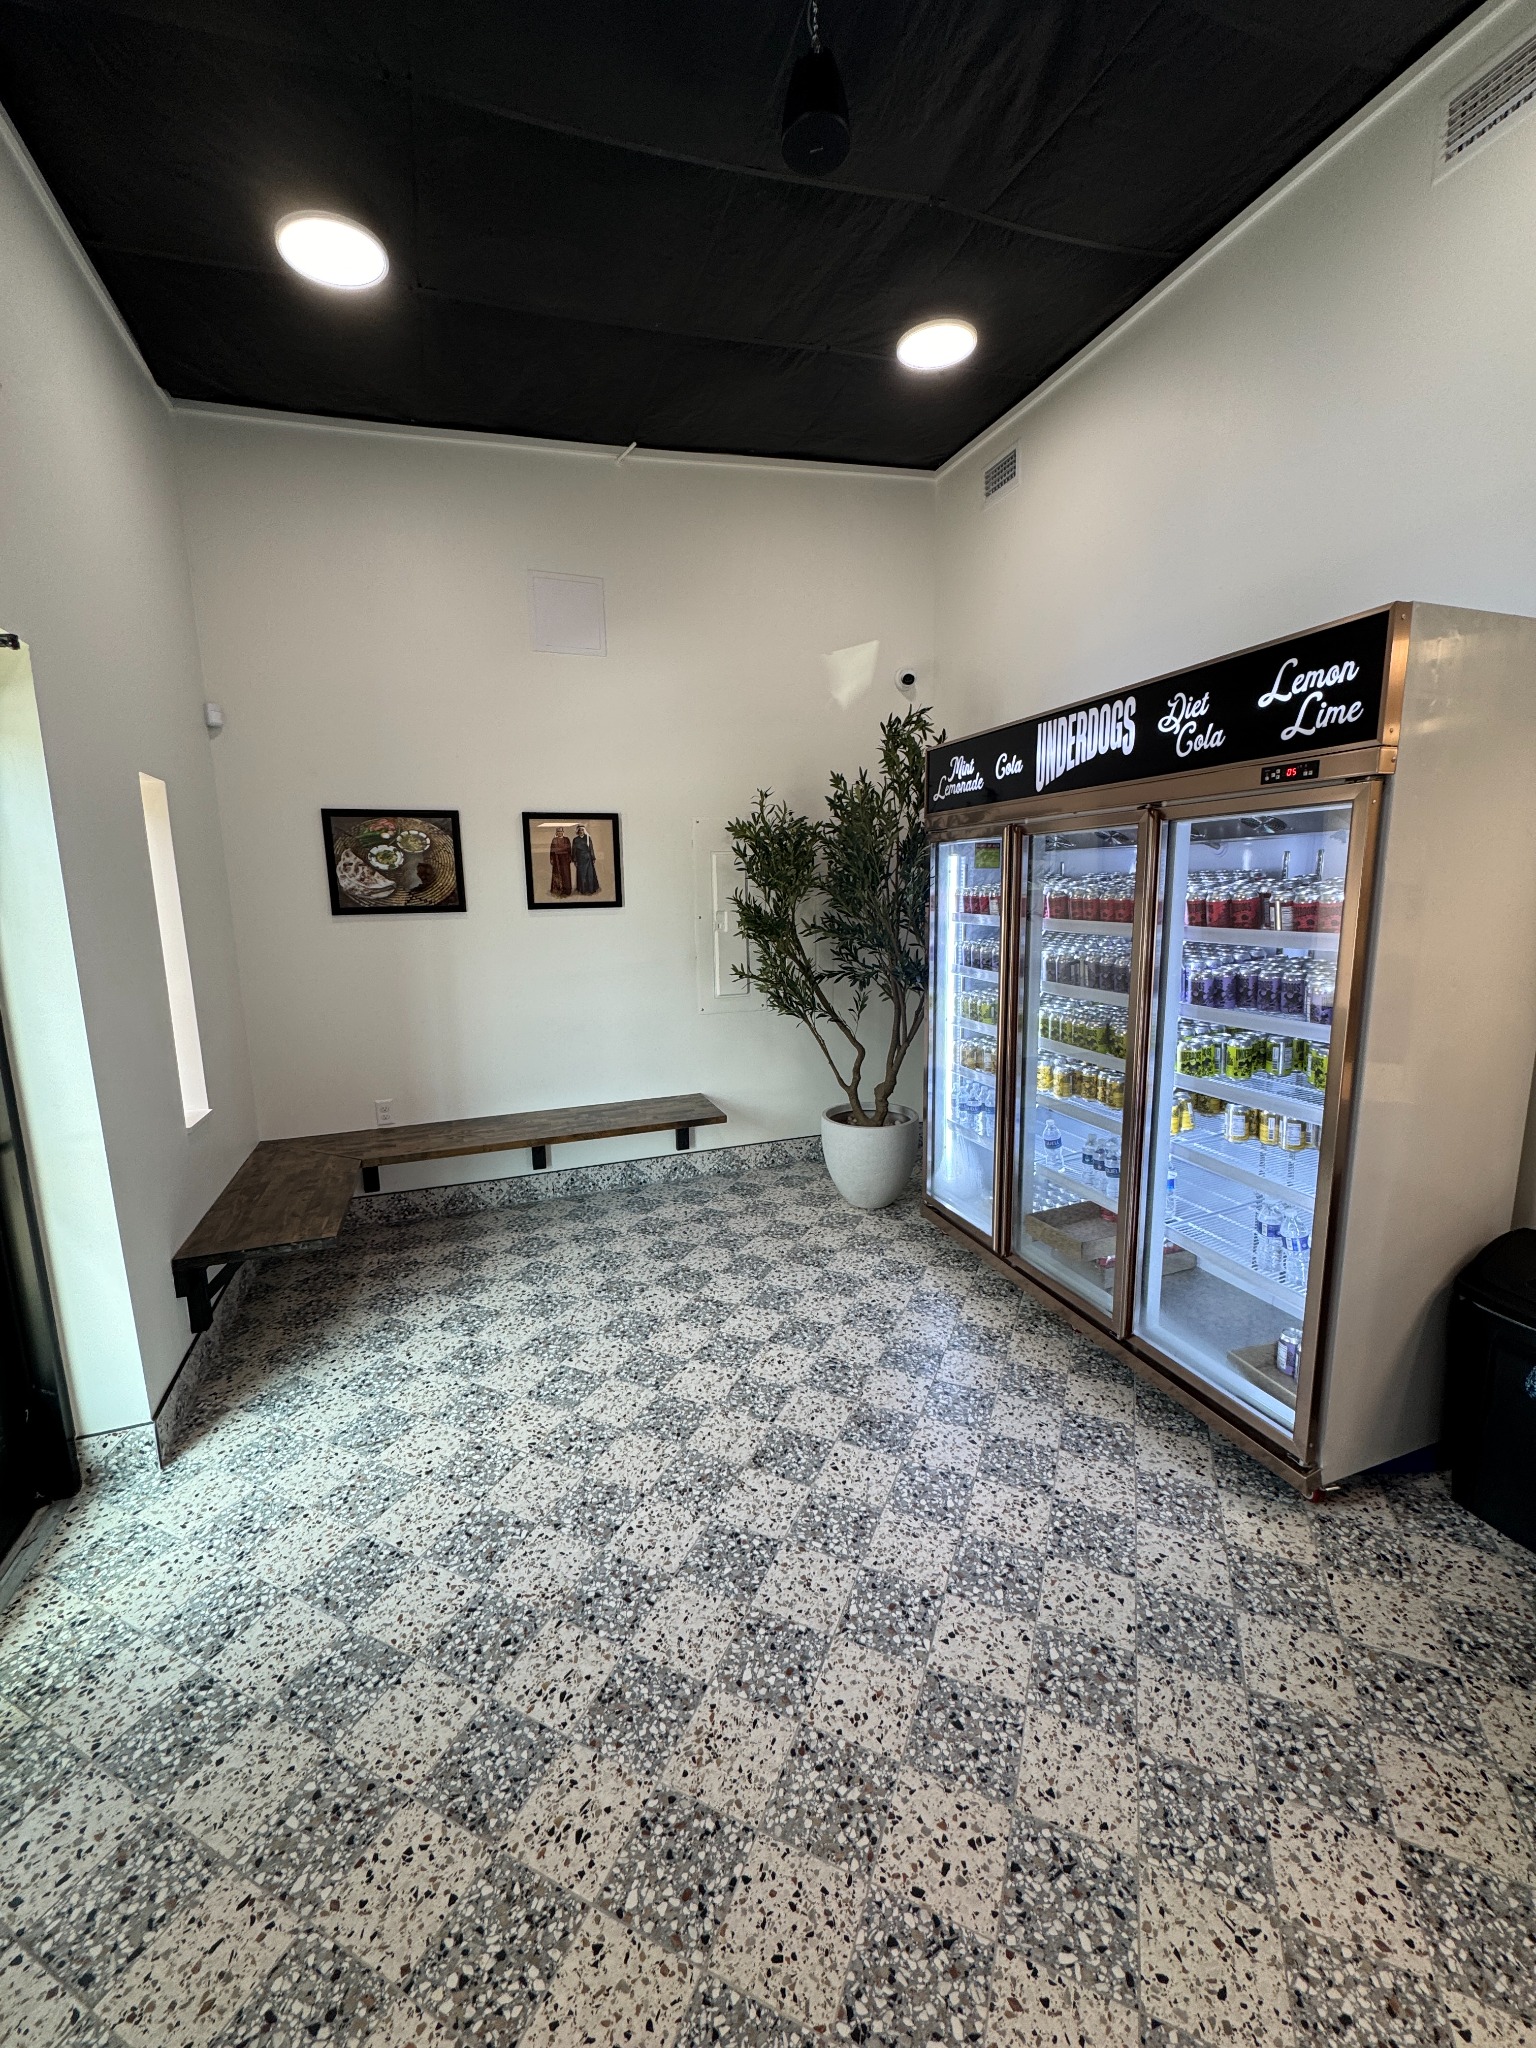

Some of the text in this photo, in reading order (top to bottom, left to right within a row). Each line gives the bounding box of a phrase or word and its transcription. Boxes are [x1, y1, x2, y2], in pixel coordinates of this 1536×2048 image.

[1257, 657, 1360, 708] Lemon
[1157, 691, 1210, 735] Diet
[1280, 691, 1364, 741] Lime
[1035, 696, 1137, 793] UNDERDOGS
[1175, 720, 1226, 758] Cola
[932, 771, 985, 802] Lemonade
[947, 755, 975, 783] Mint
[995, 752, 1024, 780] Cola
